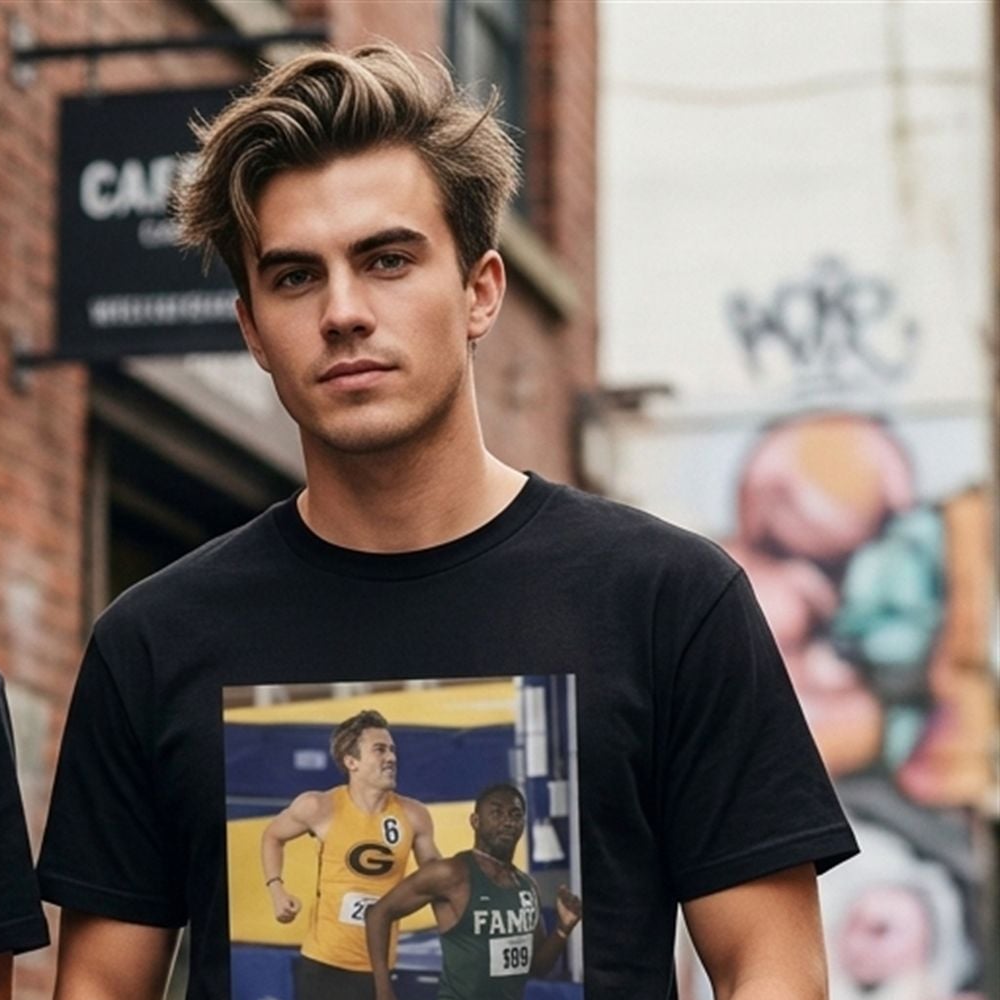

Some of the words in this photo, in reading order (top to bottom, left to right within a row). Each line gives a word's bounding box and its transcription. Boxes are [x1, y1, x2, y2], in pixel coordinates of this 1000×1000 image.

[79, 155, 182, 221] CAF
[384, 818, 399, 844] 6
[348, 842, 396, 876] G
